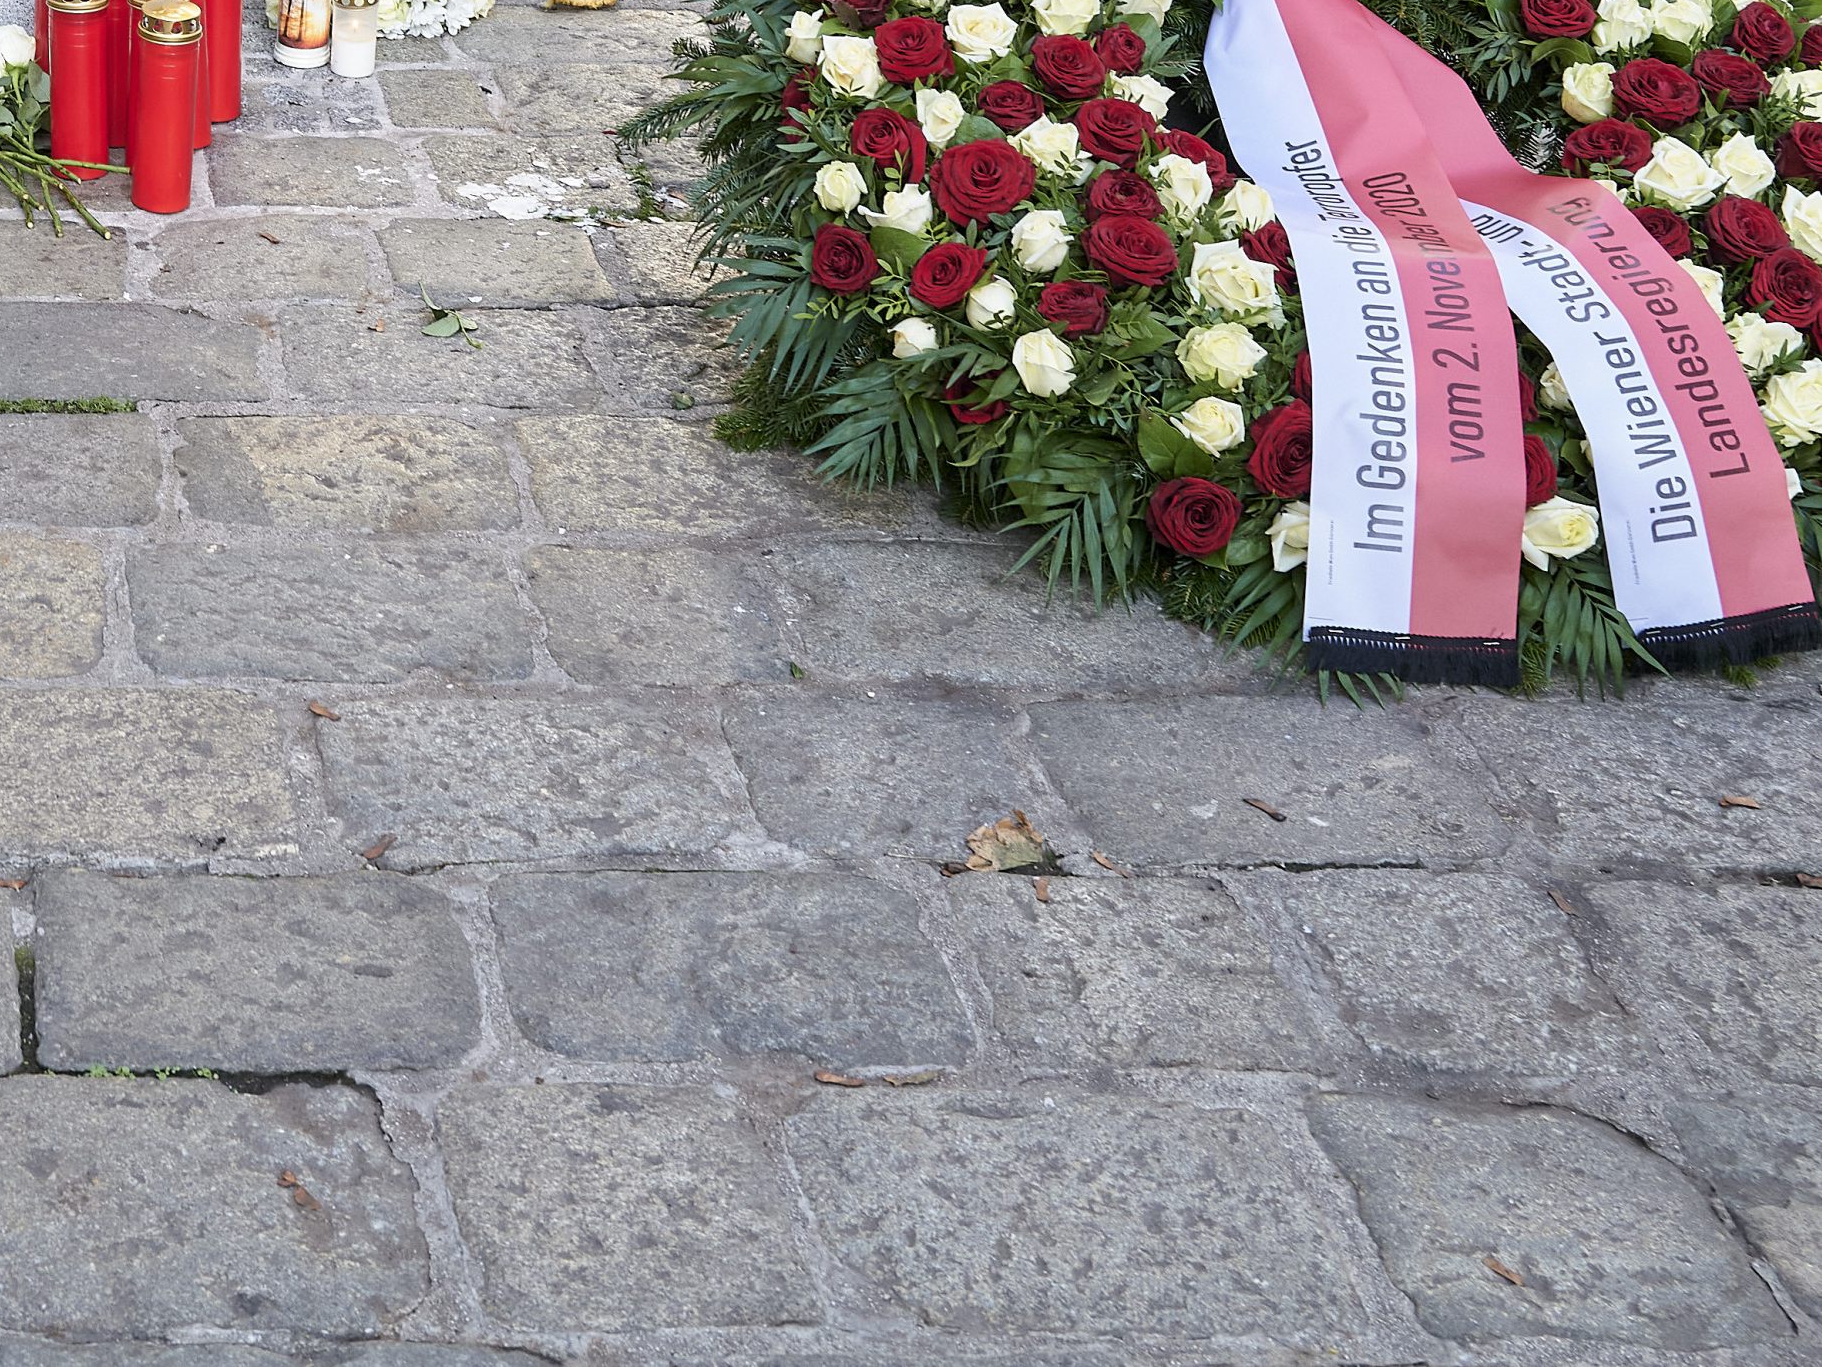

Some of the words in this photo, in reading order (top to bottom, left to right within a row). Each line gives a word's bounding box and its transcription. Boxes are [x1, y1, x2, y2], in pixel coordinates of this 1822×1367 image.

[1282, 139, 1363, 222] Terroropfer
[1362, 172, 1427, 217] 2020
[1332, 225, 1381, 254] die
[1352, 260, 1392, 295] an
[1400, 219, 1475, 332] November
[1518, 240, 1611, 323] Stadt-
[1432, 342, 1480, 372] 2.
[1545, 197, 1751, 479] Landesregierung
[1355, 303, 1407, 491] Gedenken
[1446, 382, 1486, 463] vom
[1593, 331, 1677, 470] Wiener
[1353, 503, 1405, 553] Im
[1650, 475, 1698, 543] Die
